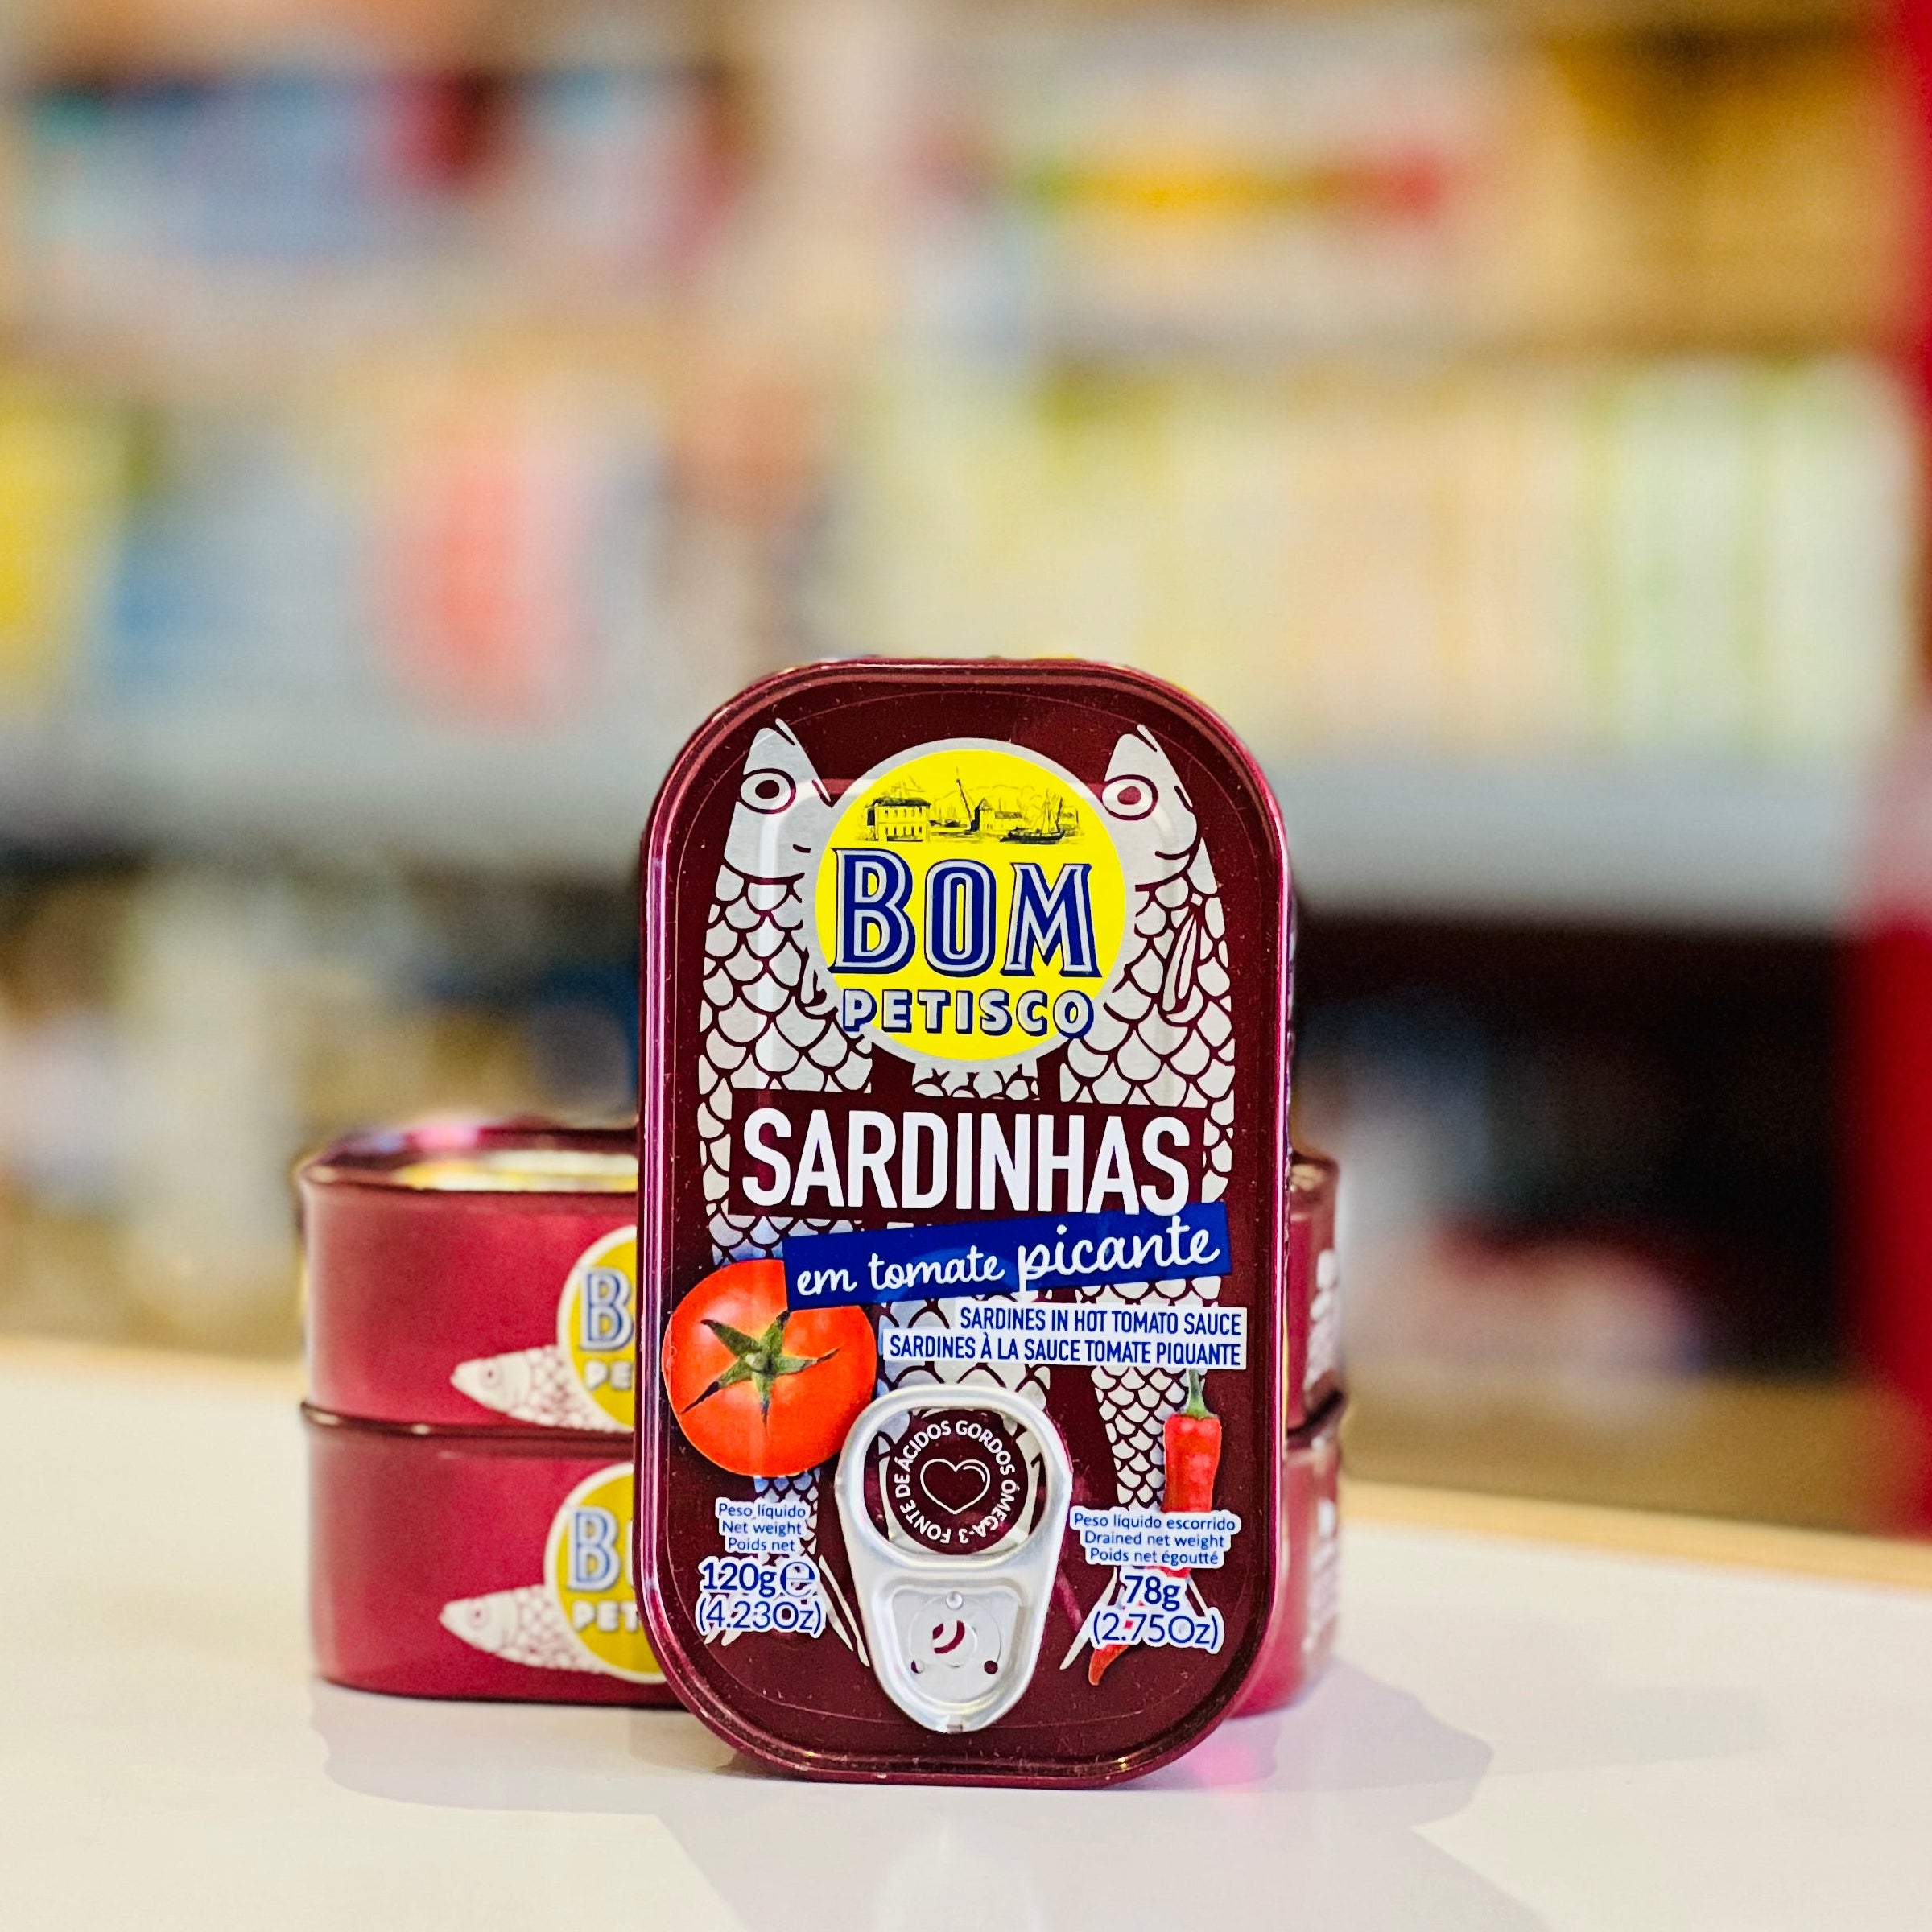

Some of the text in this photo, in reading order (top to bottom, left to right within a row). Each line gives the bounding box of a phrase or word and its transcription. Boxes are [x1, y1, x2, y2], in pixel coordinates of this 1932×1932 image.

[828, 848, 1102, 977] BOM
[843, 988, 1094, 1038] PETISCO
[742, 1108, 1190, 1216] SARDINHAS
[797, 1215, 1220, 1295] em tomate picante
[960, 1307, 1241, 1335] SARDINES IN HOT TOMATO SAUCE
[890, 1331, 1241, 1366] SARDINES À LA SAUCE TOMATE PIQUANTE
[894, 1420, 952, 1472] ÁCIDOS
[955, 1420, 1016, 1476] GORDOS
[894, 1473, 911, 1499] DE
[718, 1503, 806, 1519] Peso líquido
[722, 1520, 802, 1537] Net weight
[899, 1499, 952, 1544] FONTE
[1074, 1513, 1236, 1531] Peso líquido escorrido
[728, 1538, 795, 1552] Poids net
[1084, 1530, 1224, 1550] Drained net weight
[1090, 1547, 1219, 1567] Poids net égoutté
[703, 1562, 778, 1598] 120g
[1125, 1575, 1181, 1612] 78g
